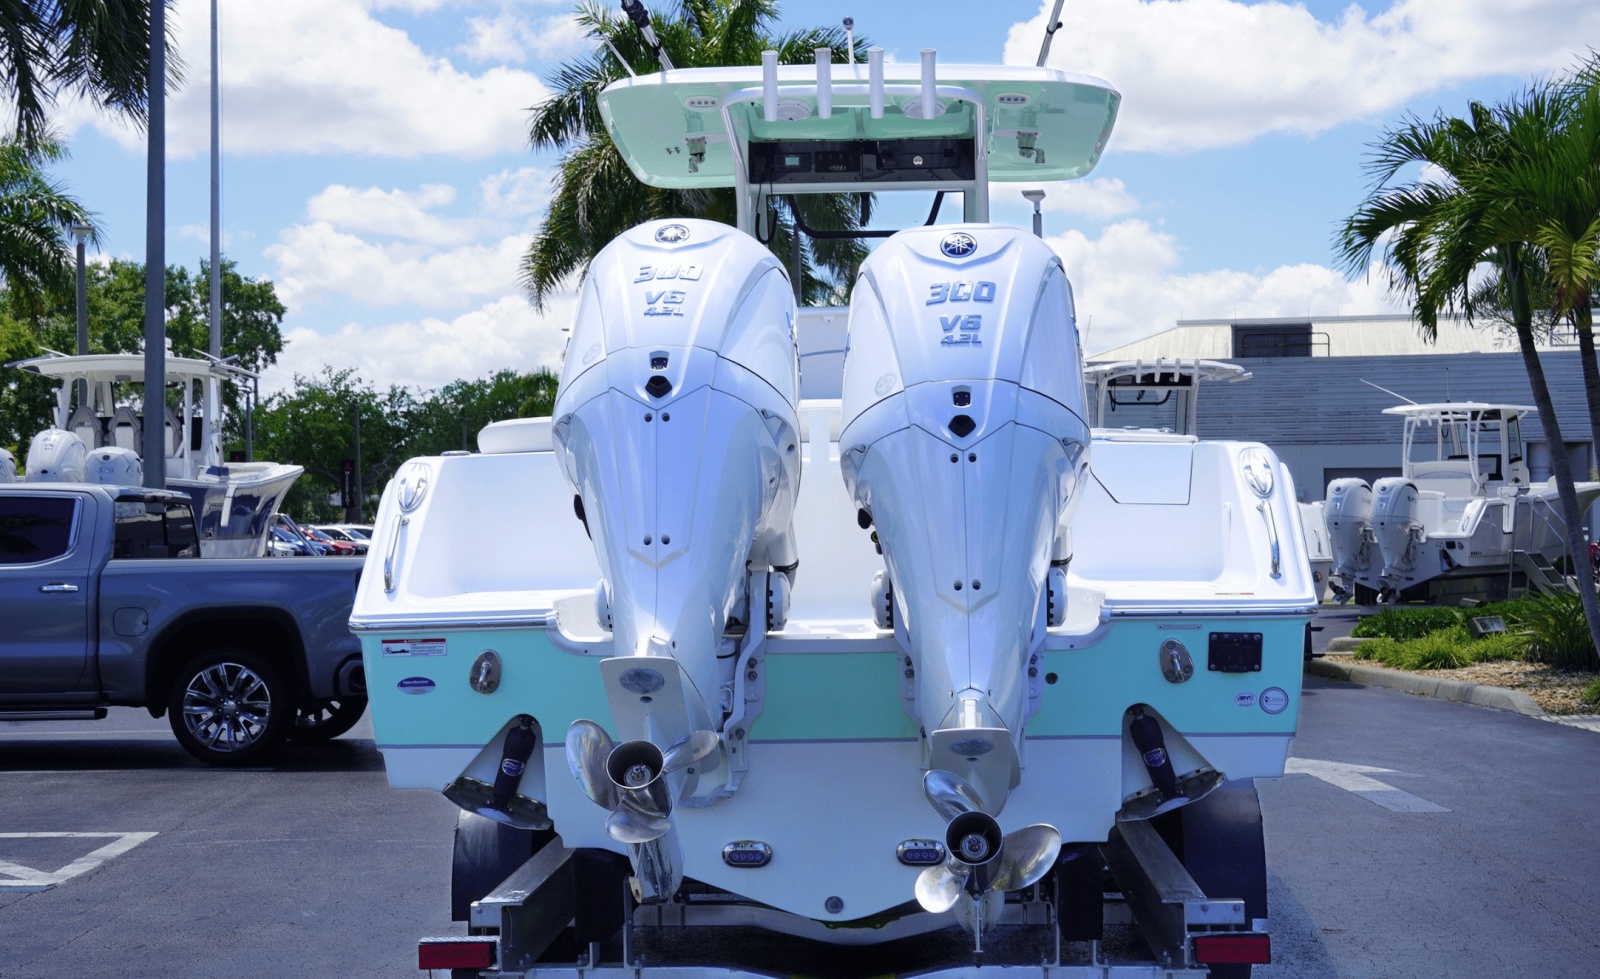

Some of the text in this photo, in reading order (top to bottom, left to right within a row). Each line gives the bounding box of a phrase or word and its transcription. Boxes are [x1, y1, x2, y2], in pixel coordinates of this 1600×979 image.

[633, 265, 704, 284] 300
[645, 290, 686, 305] V6
[926, 281, 996, 306] 300
[939, 314, 982, 332] V6
[940, 333, 983, 345] 4.2L
